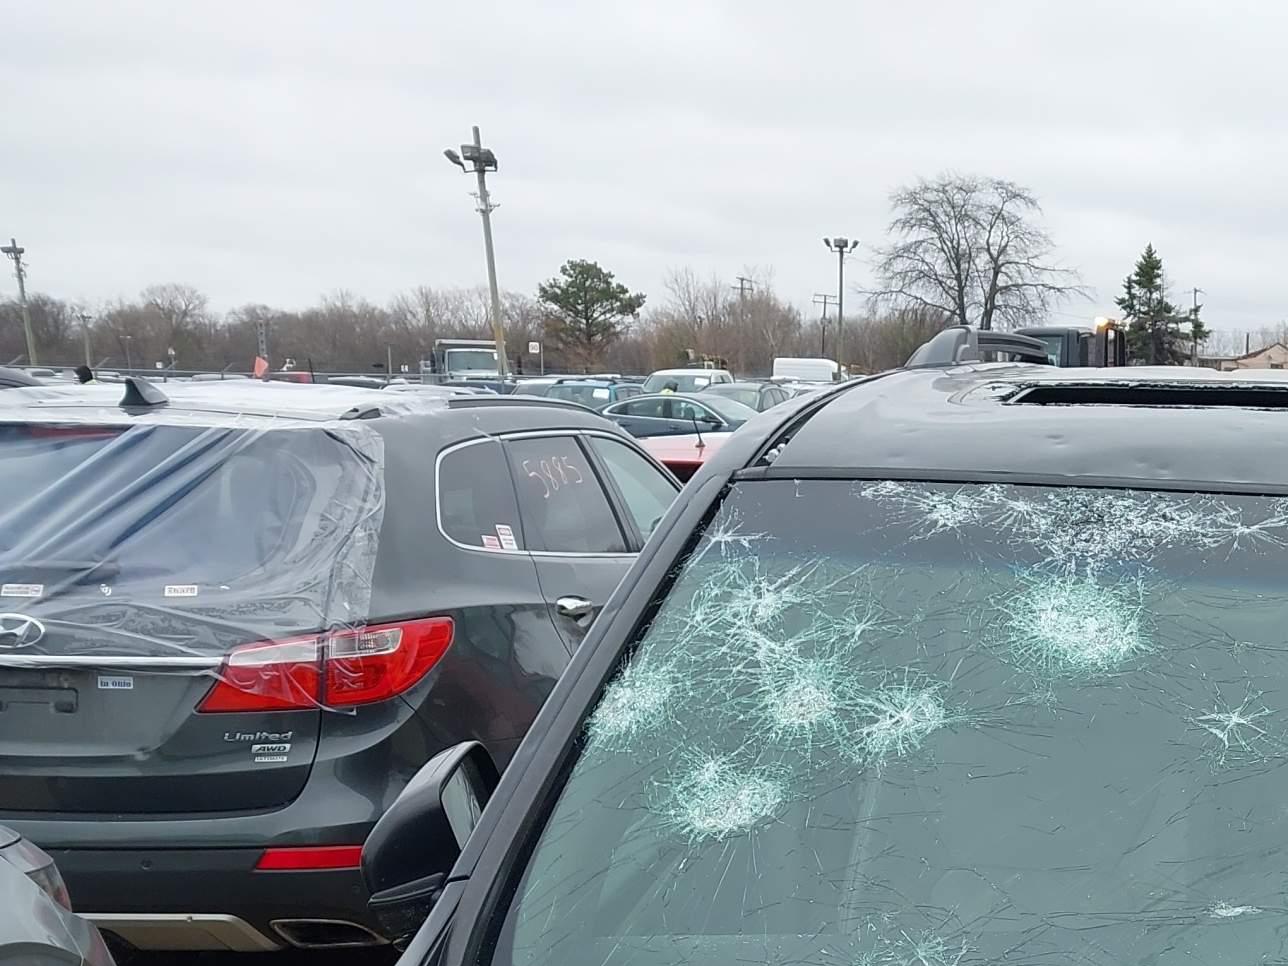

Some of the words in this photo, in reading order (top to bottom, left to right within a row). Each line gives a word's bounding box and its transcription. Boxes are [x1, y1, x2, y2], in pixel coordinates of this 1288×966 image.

[522, 455, 583, 499] 5885
[223, 731, 293, 742] Limited
[256, 745, 287, 753] AWD
